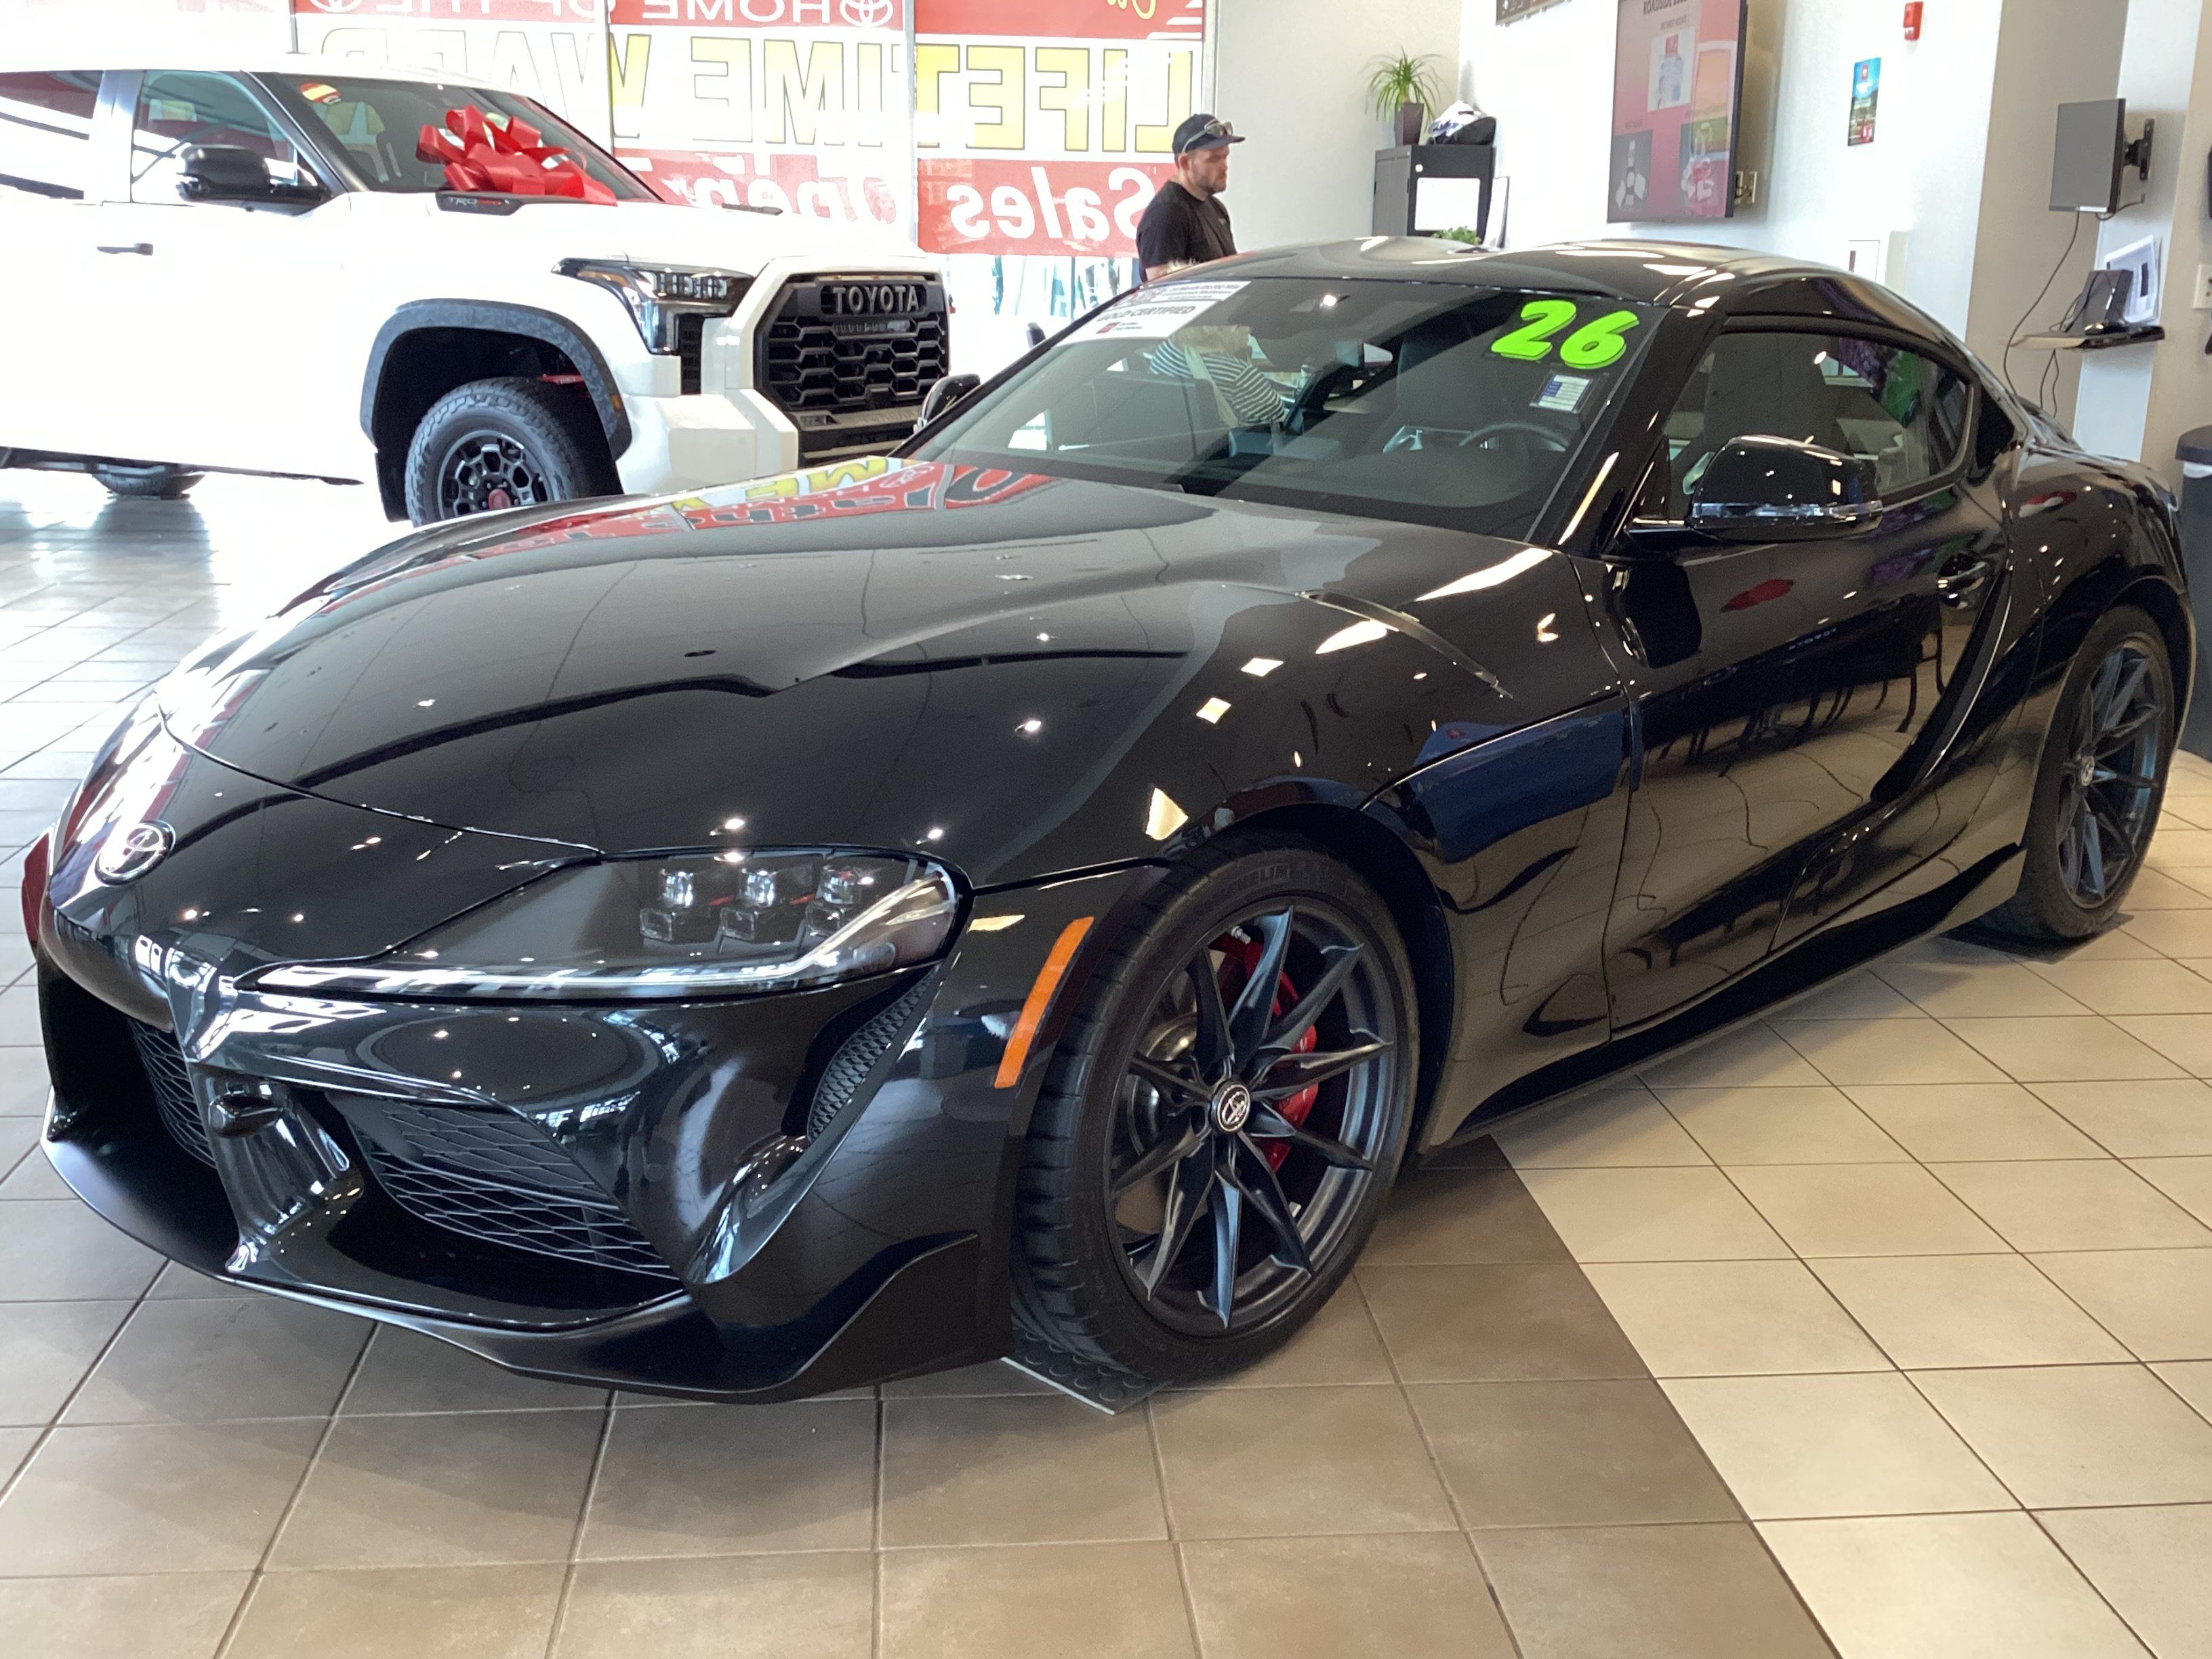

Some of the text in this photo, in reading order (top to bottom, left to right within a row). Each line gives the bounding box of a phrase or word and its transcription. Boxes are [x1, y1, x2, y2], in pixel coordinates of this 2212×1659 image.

[832, 285, 920, 315] TOYOTA
[1130, 306, 1196, 317] CERTIFIED
[1491, 299, 1639, 366] 26
